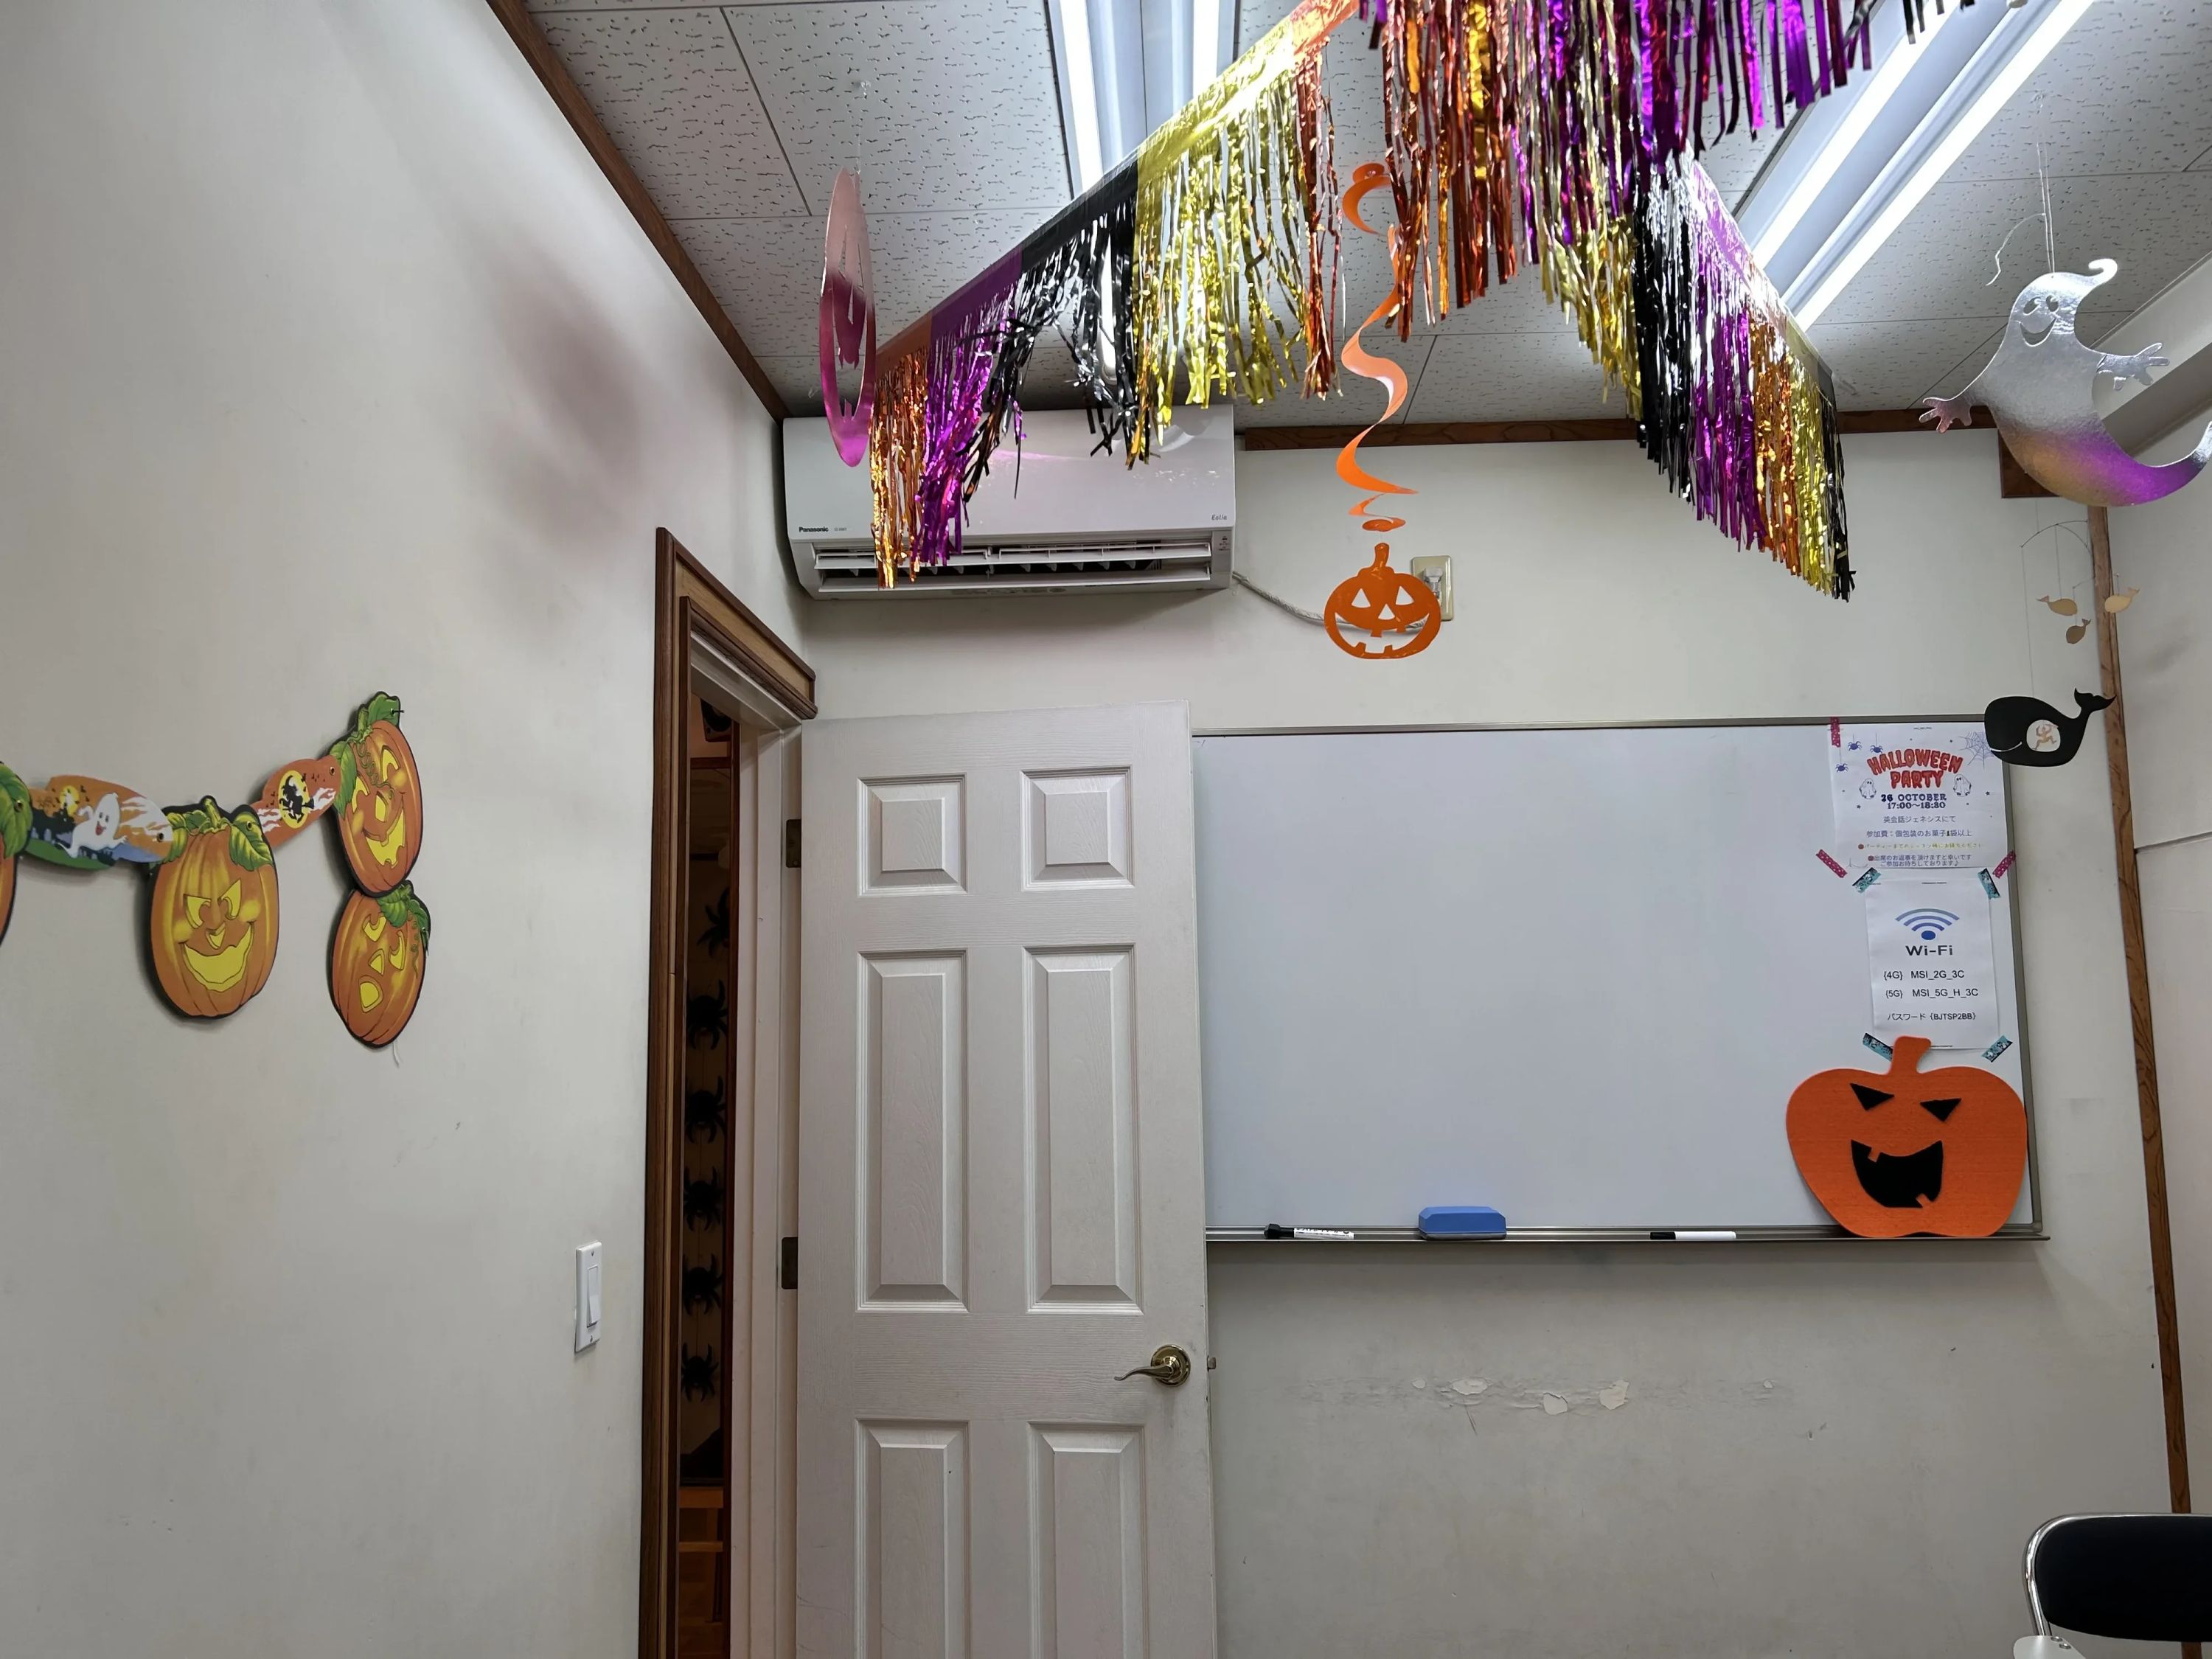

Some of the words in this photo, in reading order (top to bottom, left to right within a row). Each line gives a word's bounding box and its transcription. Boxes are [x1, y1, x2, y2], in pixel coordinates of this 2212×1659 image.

[1867, 748, 1963, 775] HALLOWEEN
[1890, 771, 1944, 789] PARTY
[1881, 794, 1893, 802] 26
[1897, 793, 1947, 802] OCTOBER
[1883, 815, 1956, 824] 英会話ジェネシスにて
[1905, 945, 1953, 956] Wi-Fi
[1910, 970, 1965, 981] MSI_2G_3C
[1912, 988, 1979, 999] MSI_5G_H_3C
